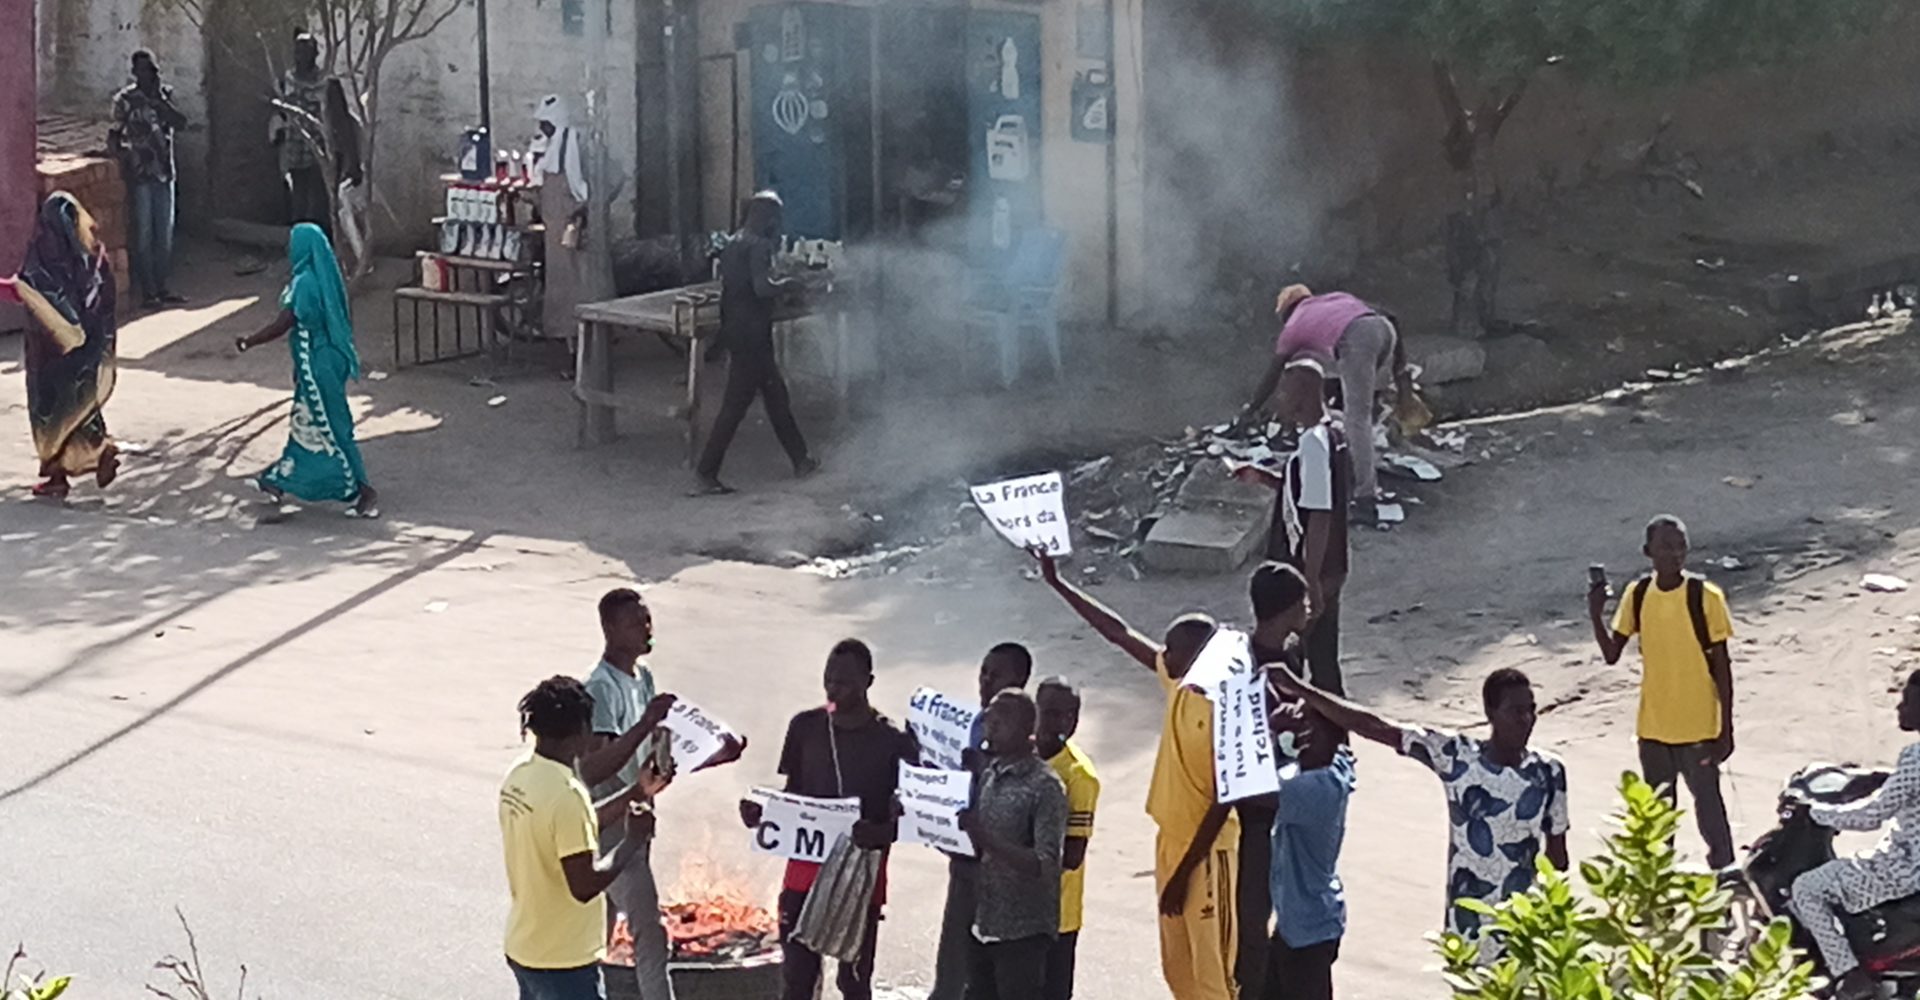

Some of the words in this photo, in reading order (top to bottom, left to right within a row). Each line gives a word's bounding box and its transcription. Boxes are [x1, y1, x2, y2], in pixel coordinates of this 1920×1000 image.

[1002, 481, 1060, 501] France
[910, 687, 928, 711] La
[927, 693, 974, 731] France
[1217, 679, 1228, 761] France
[1219, 769, 1230, 797] La
